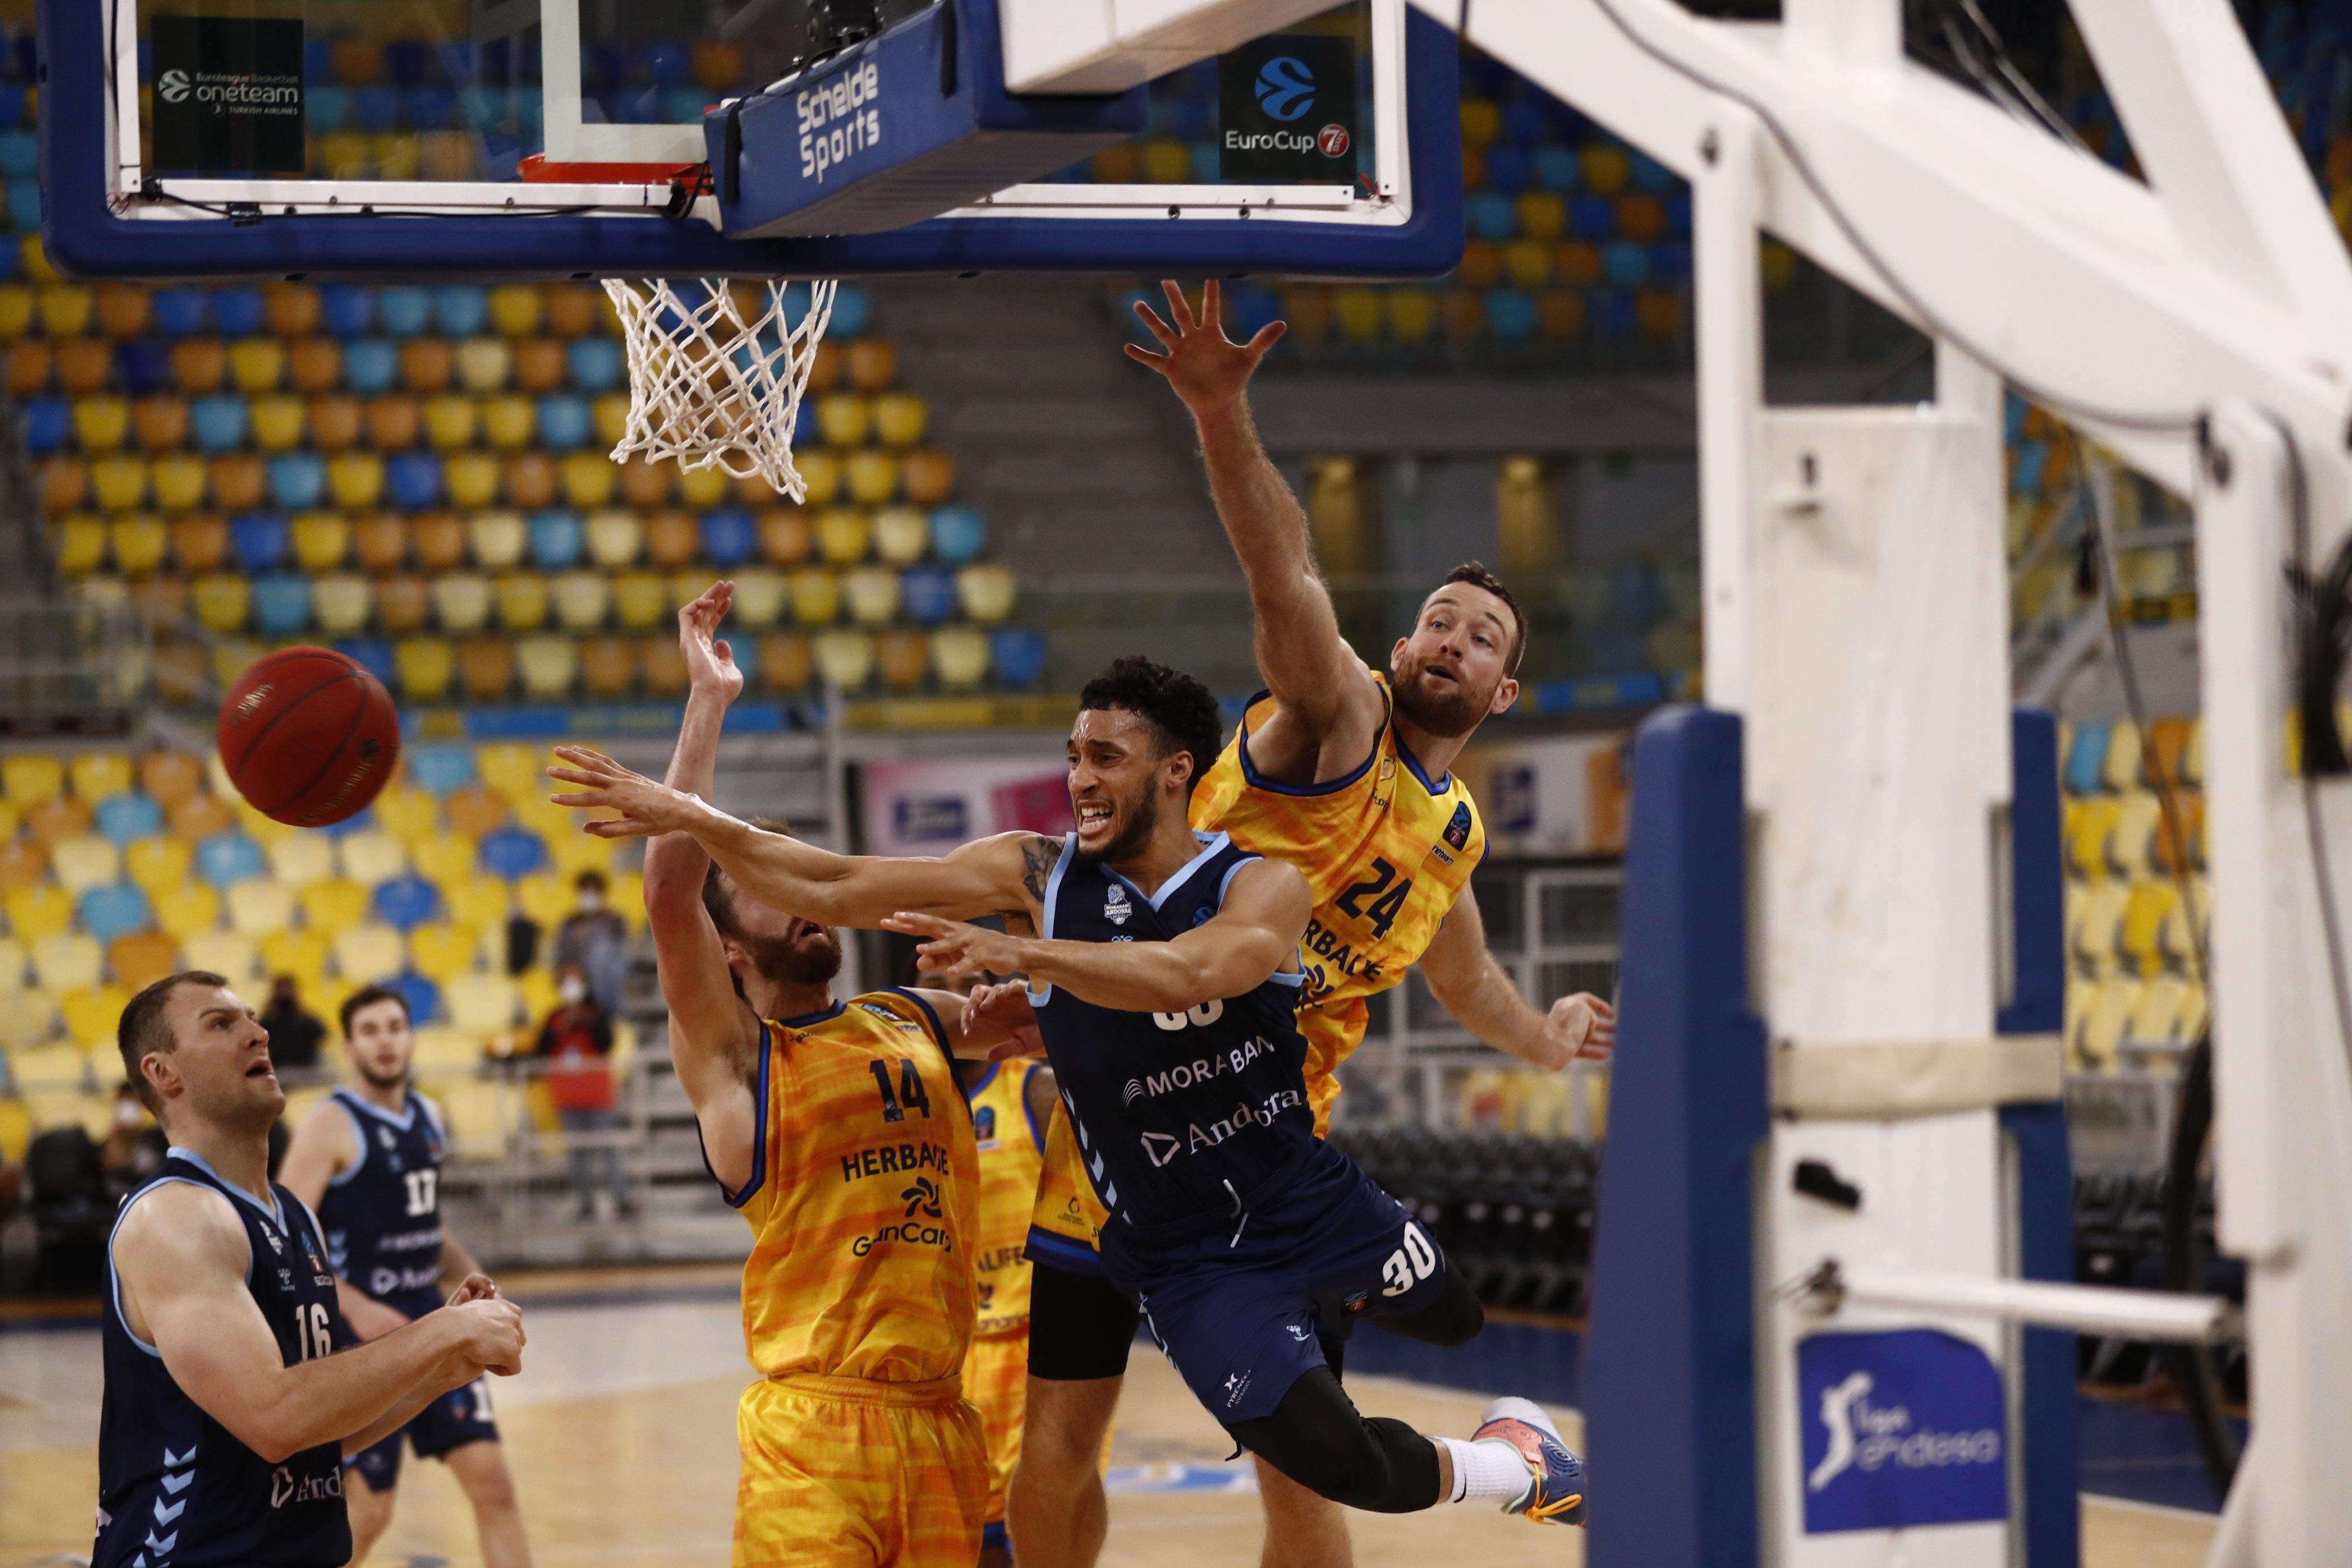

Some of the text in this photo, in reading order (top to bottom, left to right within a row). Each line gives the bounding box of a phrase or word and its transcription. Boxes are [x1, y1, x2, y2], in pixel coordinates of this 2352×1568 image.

[196, 84, 299, 103] oneteam
[797, 61, 879, 135] Schelde
[800, 108, 880, 184] Sports
[1225, 130, 1315, 154] EuroCup
[1334, 856, 1413, 940] 24
[869, 1059, 930, 1122] 14
[1382, 1221, 1436, 1297] 30
[296, 1302, 331, 1362] 16
